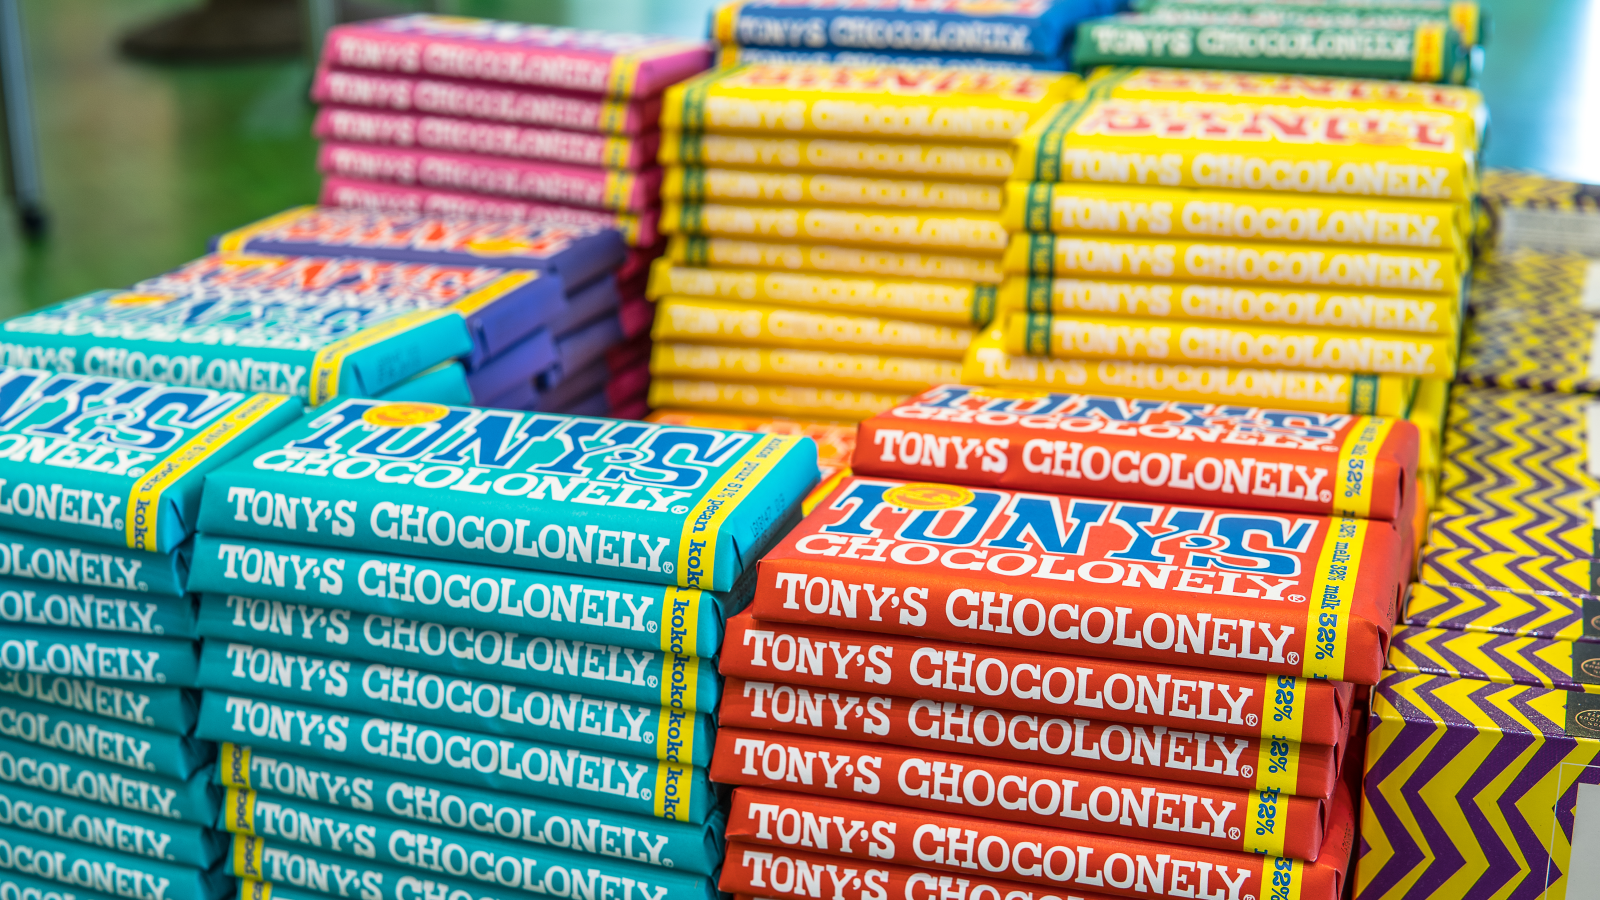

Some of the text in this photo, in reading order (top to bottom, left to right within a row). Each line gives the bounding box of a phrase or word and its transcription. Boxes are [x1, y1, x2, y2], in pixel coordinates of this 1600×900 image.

[253, 449, 692, 513] CHOCOLONELY
[284, 398, 753, 490] TONY'S
[874, 429, 1328, 502] TONY'S CHOCOLONELY
[1345, 458, 1364, 498] 32%
[227, 486, 670, 574] TONY'S CHOCOLONELY
[692, 498, 725, 533] pecan
[818, 479, 1319, 577] TONY'S
[1333, 542, 1351, 563] melk
[218, 544, 654, 631] TONY'S CHOCOLONELY
[795, 534, 1308, 602] CHOCOLONELY
[1321, 585, 1340, 610] melk
[226, 595, 654, 686] TONY'S CHOCOLONELY
[776, 572, 1295, 664] TONY'S CHOCOLONELY
[1315, 613, 1338, 660] 32%
[226, 643, 650, 742] TONY'S CHOCOLONELY
[743, 629, 1253, 726] TONY'S CHOCOLONELY
[1273, 675, 1296, 722] 32%
[226, 697, 648, 799] TONY'S CHOCOLONELY
[744, 681, 1248, 777] TONY'S CHOCOLONELY
[252, 756, 668, 865] TONY'S CHOCOLONELY
[256, 801, 376, 858] TONY'S
[734, 738, 1236, 839] TONY'S CHOCOLONELY
[264, 847, 383, 900] TONY'S
[742, 850, 889, 900] TONY'S
[748, 802, 896, 859] TONY'S
[913, 824, 1251, 900] CHOCOLONELY
